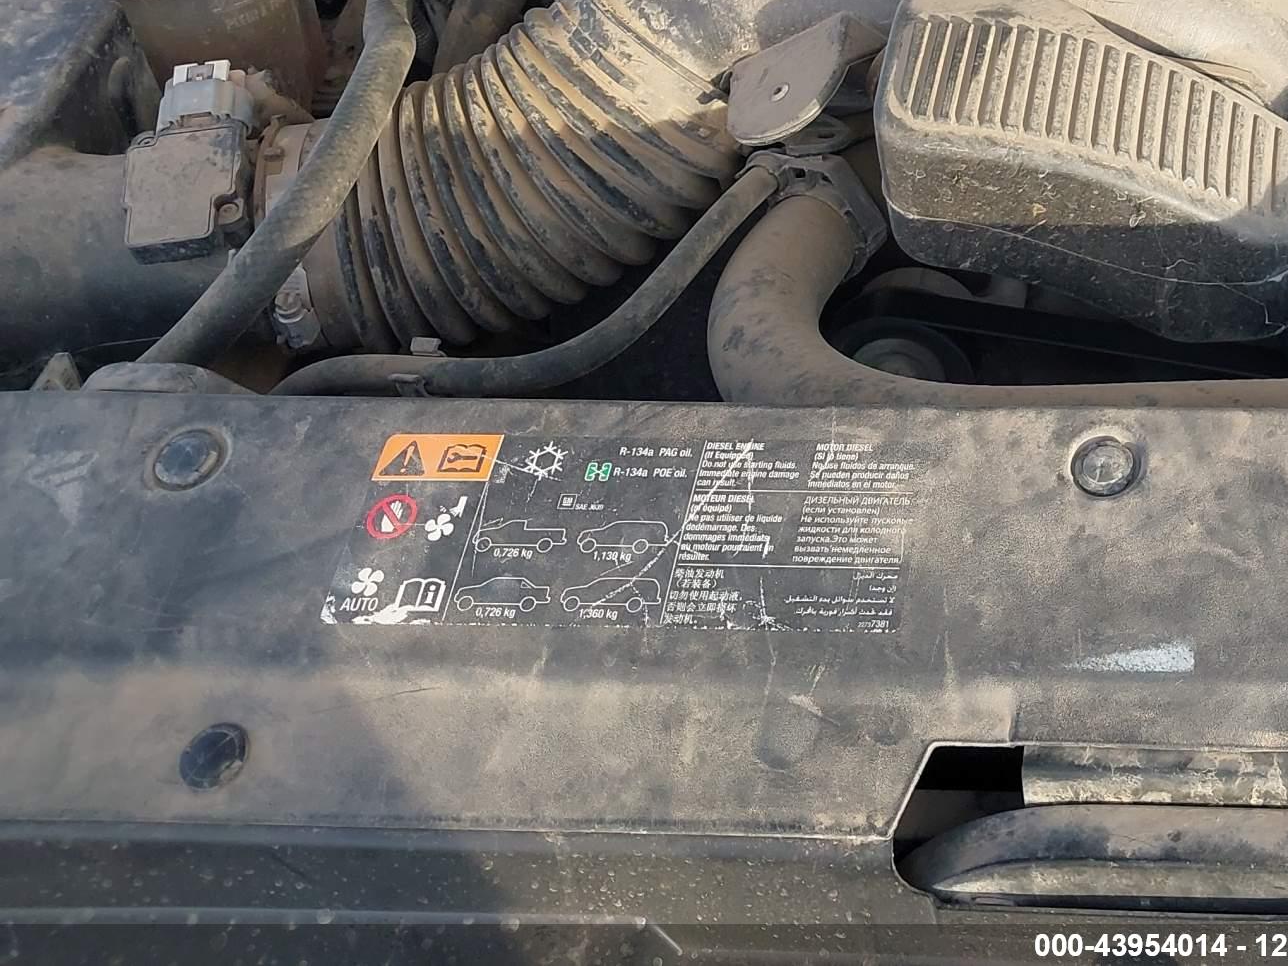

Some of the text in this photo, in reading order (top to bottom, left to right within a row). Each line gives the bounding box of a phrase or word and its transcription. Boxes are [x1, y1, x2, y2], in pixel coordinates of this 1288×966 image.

[707, 442, 766, 451] DIESEL ENINE
[619, 447, 693, 457] R-134a PAG oil.
[702, 460, 713, 468] Do
[868, 462, 878, 470] de
[613, 468, 688, 478] R-134a POE oil.
[769, 471, 800, 480] damage
[852, 472, 884, 481] producir
[693, 494, 727, 503] MOTEUR
[756, 514, 783, 524] liquide
[683, 533, 726, 542] dommages
[493, 548, 533, 559] 0,726 kg
[619, 552, 631, 561] kg
[339, 597, 379, 611] AUTO
[475, 607, 516, 618] 0,726 kg
[606, 609, 618, 619] kg
